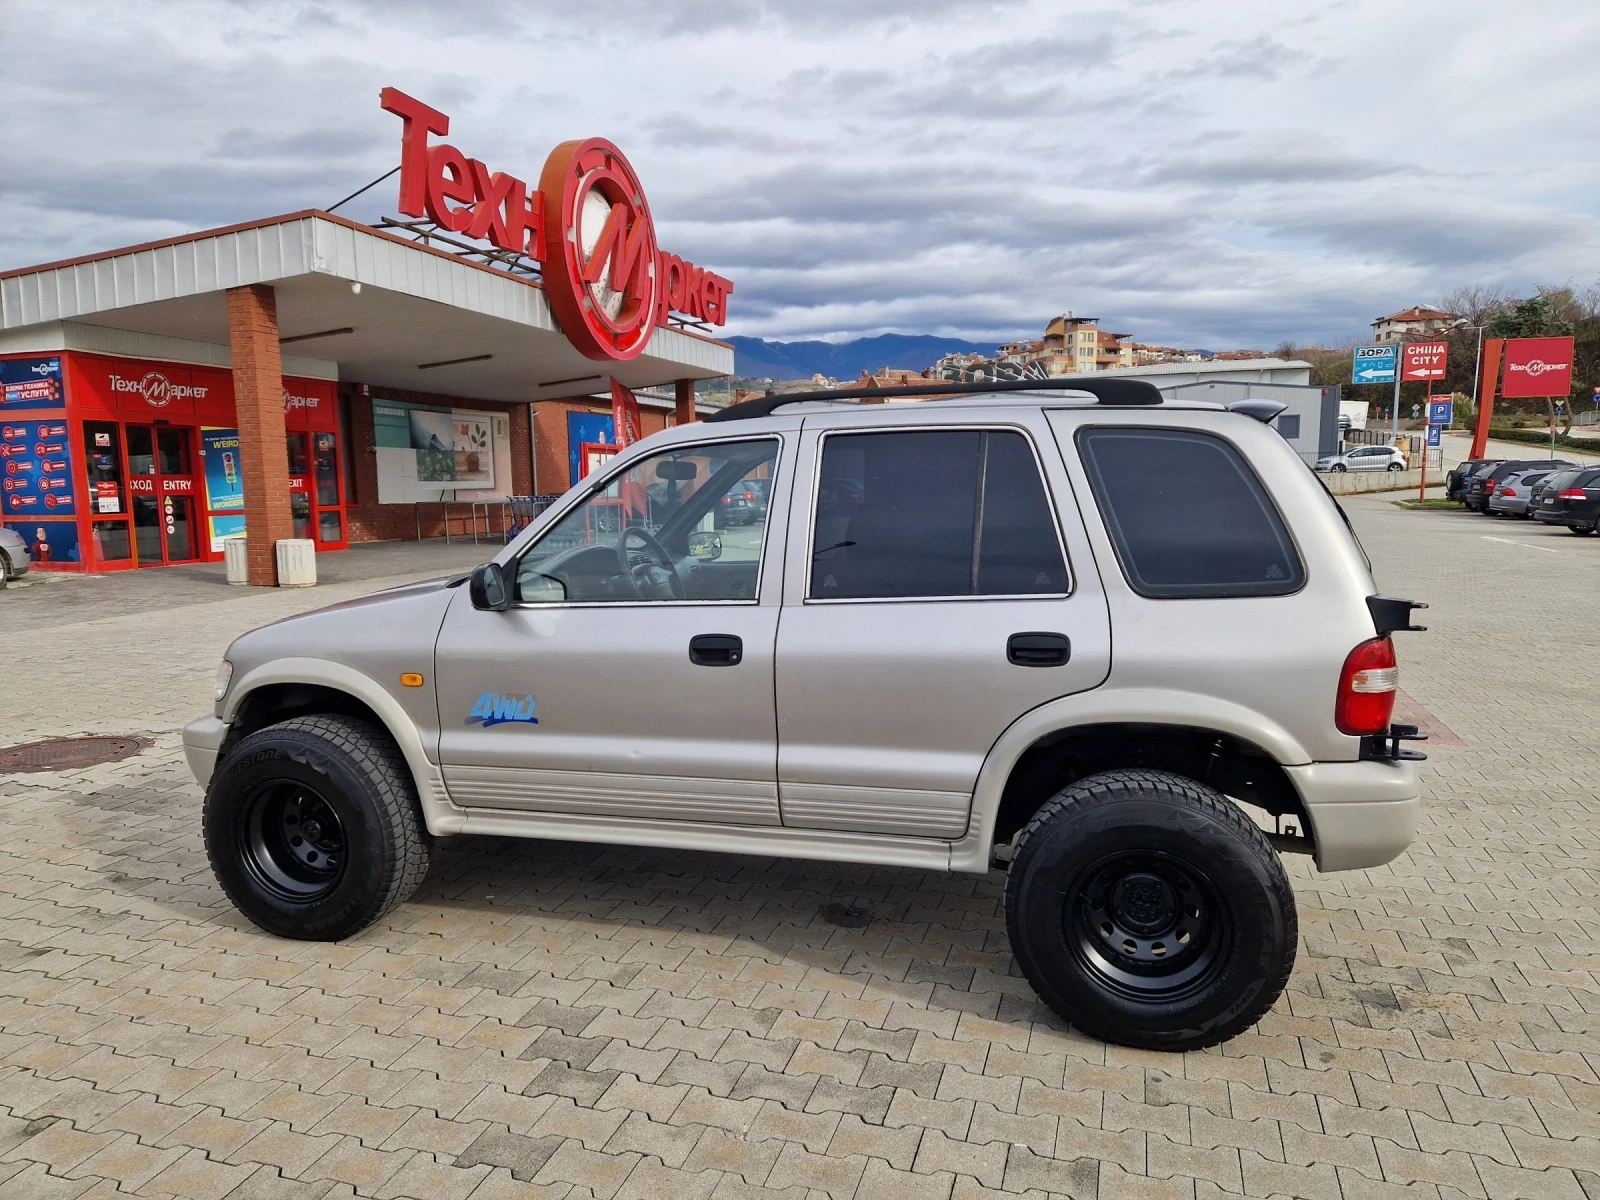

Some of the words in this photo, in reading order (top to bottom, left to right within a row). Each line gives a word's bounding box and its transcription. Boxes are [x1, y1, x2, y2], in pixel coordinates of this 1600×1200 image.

[1359, 348, 1393, 357] ЗОРА
[1407, 345, 1445, 355] CHINA
[1411, 355, 1440, 365] CITY
[20, 388, 49, 399] УСЛУГИ
[213, 439, 239, 449] WEIRD
[163, 480, 192, 491] ENTRY
[288, 478, 303, 488] EXIT
[470, 691, 536, 721] 4WD
